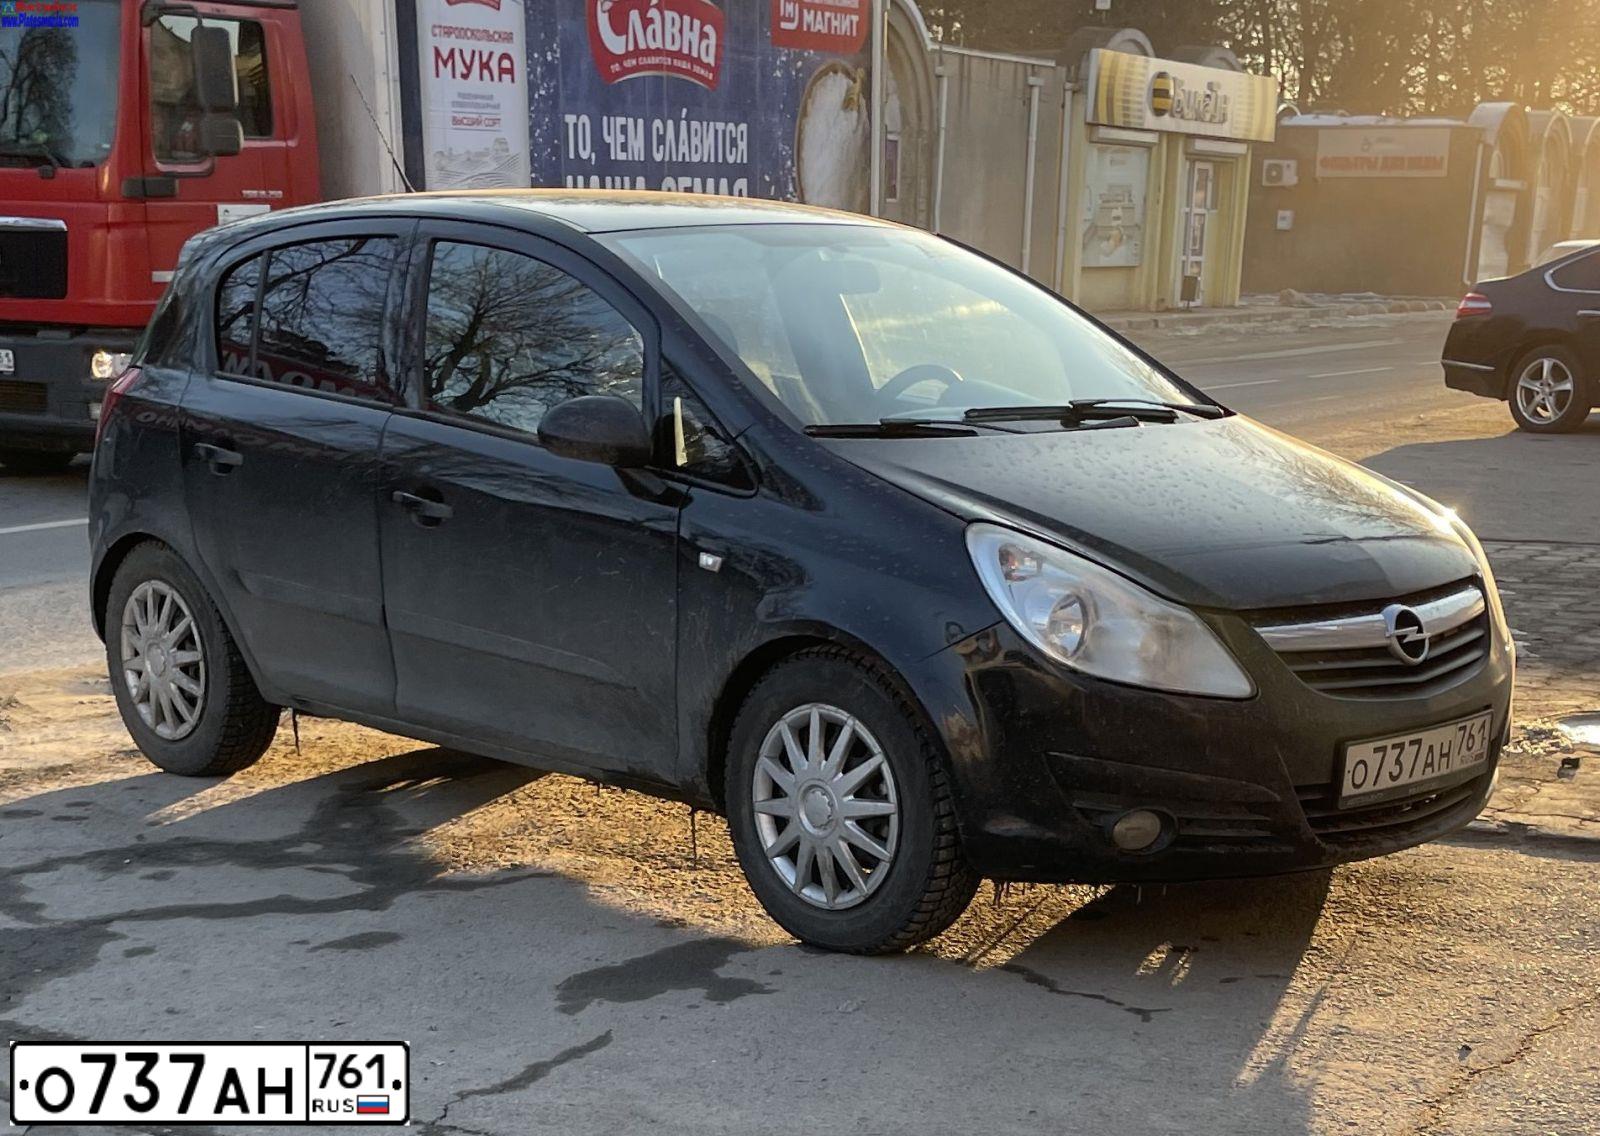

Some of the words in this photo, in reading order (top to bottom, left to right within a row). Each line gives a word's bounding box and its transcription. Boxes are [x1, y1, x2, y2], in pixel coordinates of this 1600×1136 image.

[803, 8, 859, 37] МАГНИТ
[433, 45, 515, 84] МУКА
[564, 114, 595, 165] ТО,
[602, 115, 645, 162] ЧЕМ
[1458, 719, 1486, 756] 761
